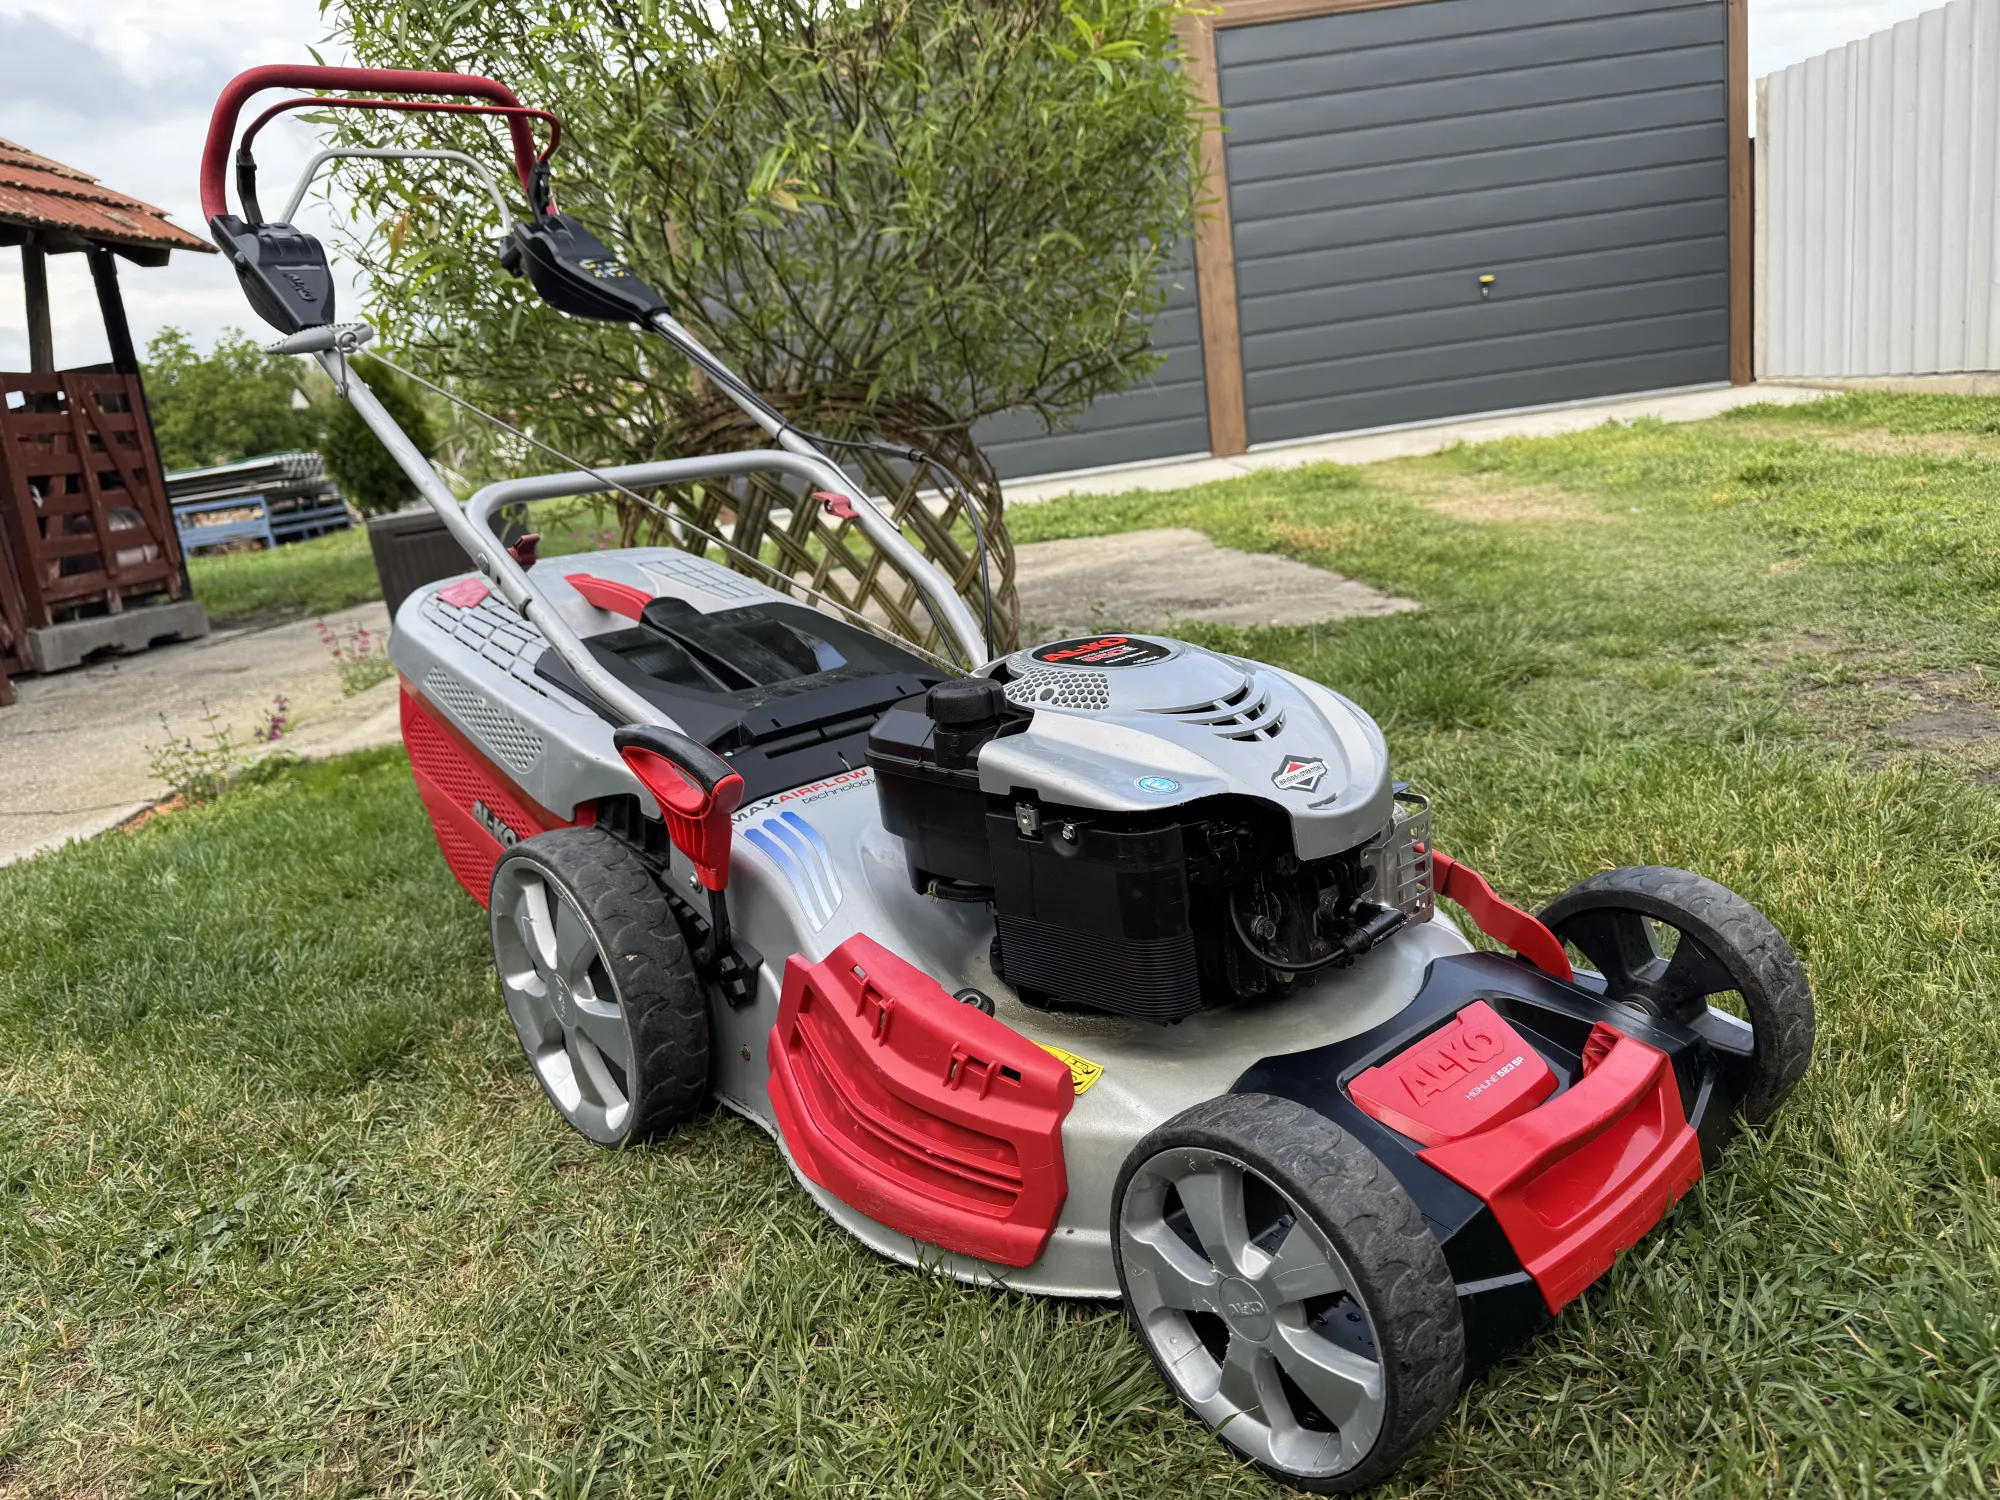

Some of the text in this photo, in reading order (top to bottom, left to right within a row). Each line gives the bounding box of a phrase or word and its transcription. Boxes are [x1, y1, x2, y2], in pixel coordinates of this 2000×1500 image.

[802, 778, 876, 805] technology
[1465, 1056, 1524, 1100] HIGHLINE 523 SP
